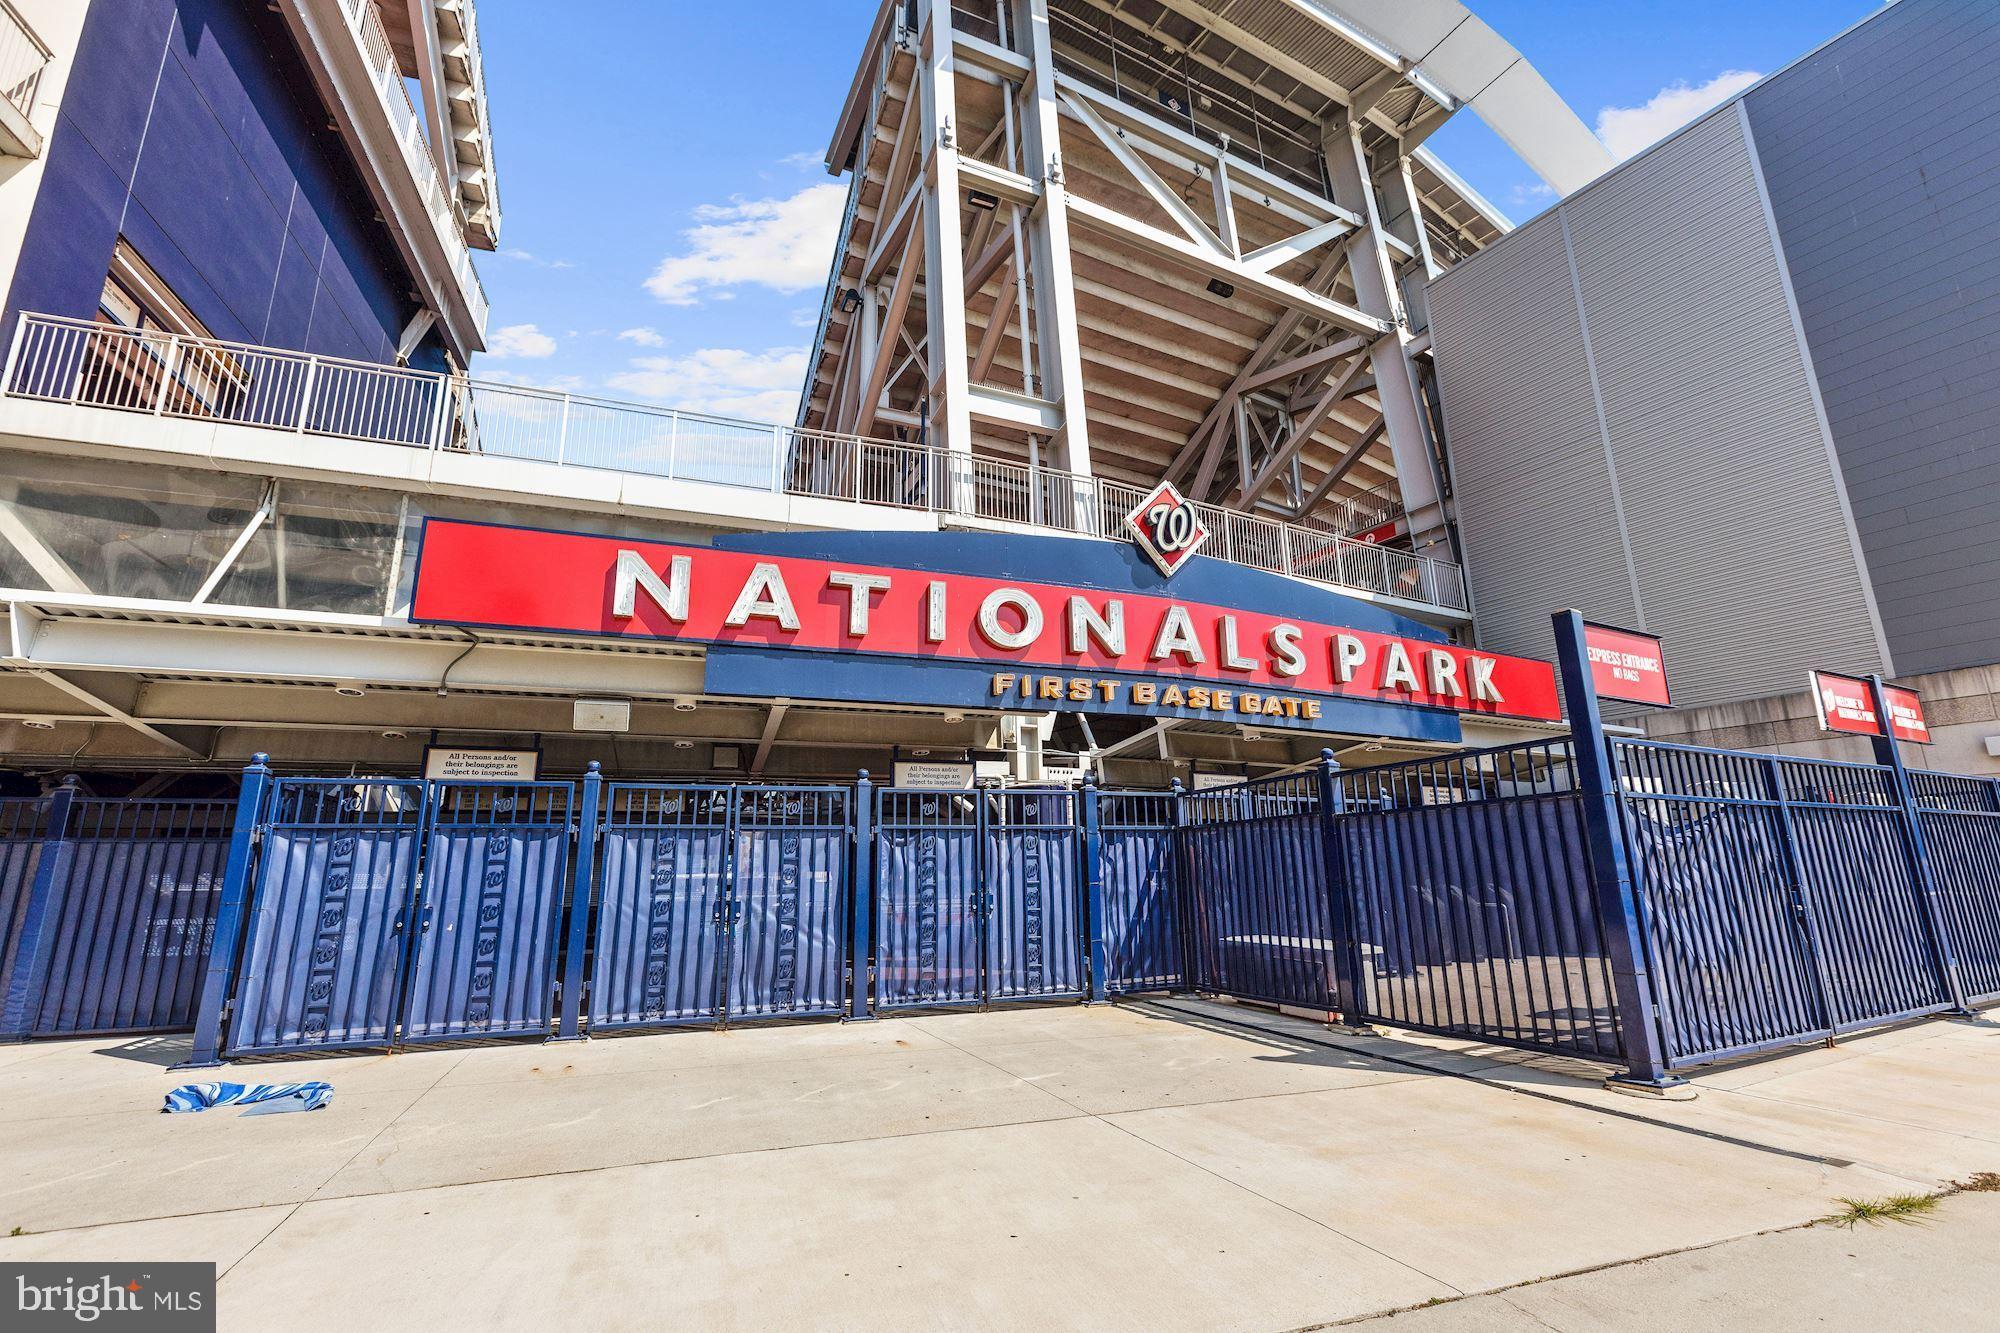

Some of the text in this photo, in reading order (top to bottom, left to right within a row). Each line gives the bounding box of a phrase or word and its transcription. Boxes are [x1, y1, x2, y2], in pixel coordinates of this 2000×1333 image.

[1144, 500, 1197, 554] W
[612, 549, 1506, 703] NATIONALS PARK
[1587, 646, 1660, 673] EXPRESS ENTRANCE
[1613, 667, 1640, 682] NO BAGS
[993, 672, 1323, 719] FIRST BASE GATE
[462, 753, 492, 761] Persons
[465, 761, 505, 769] belongings
